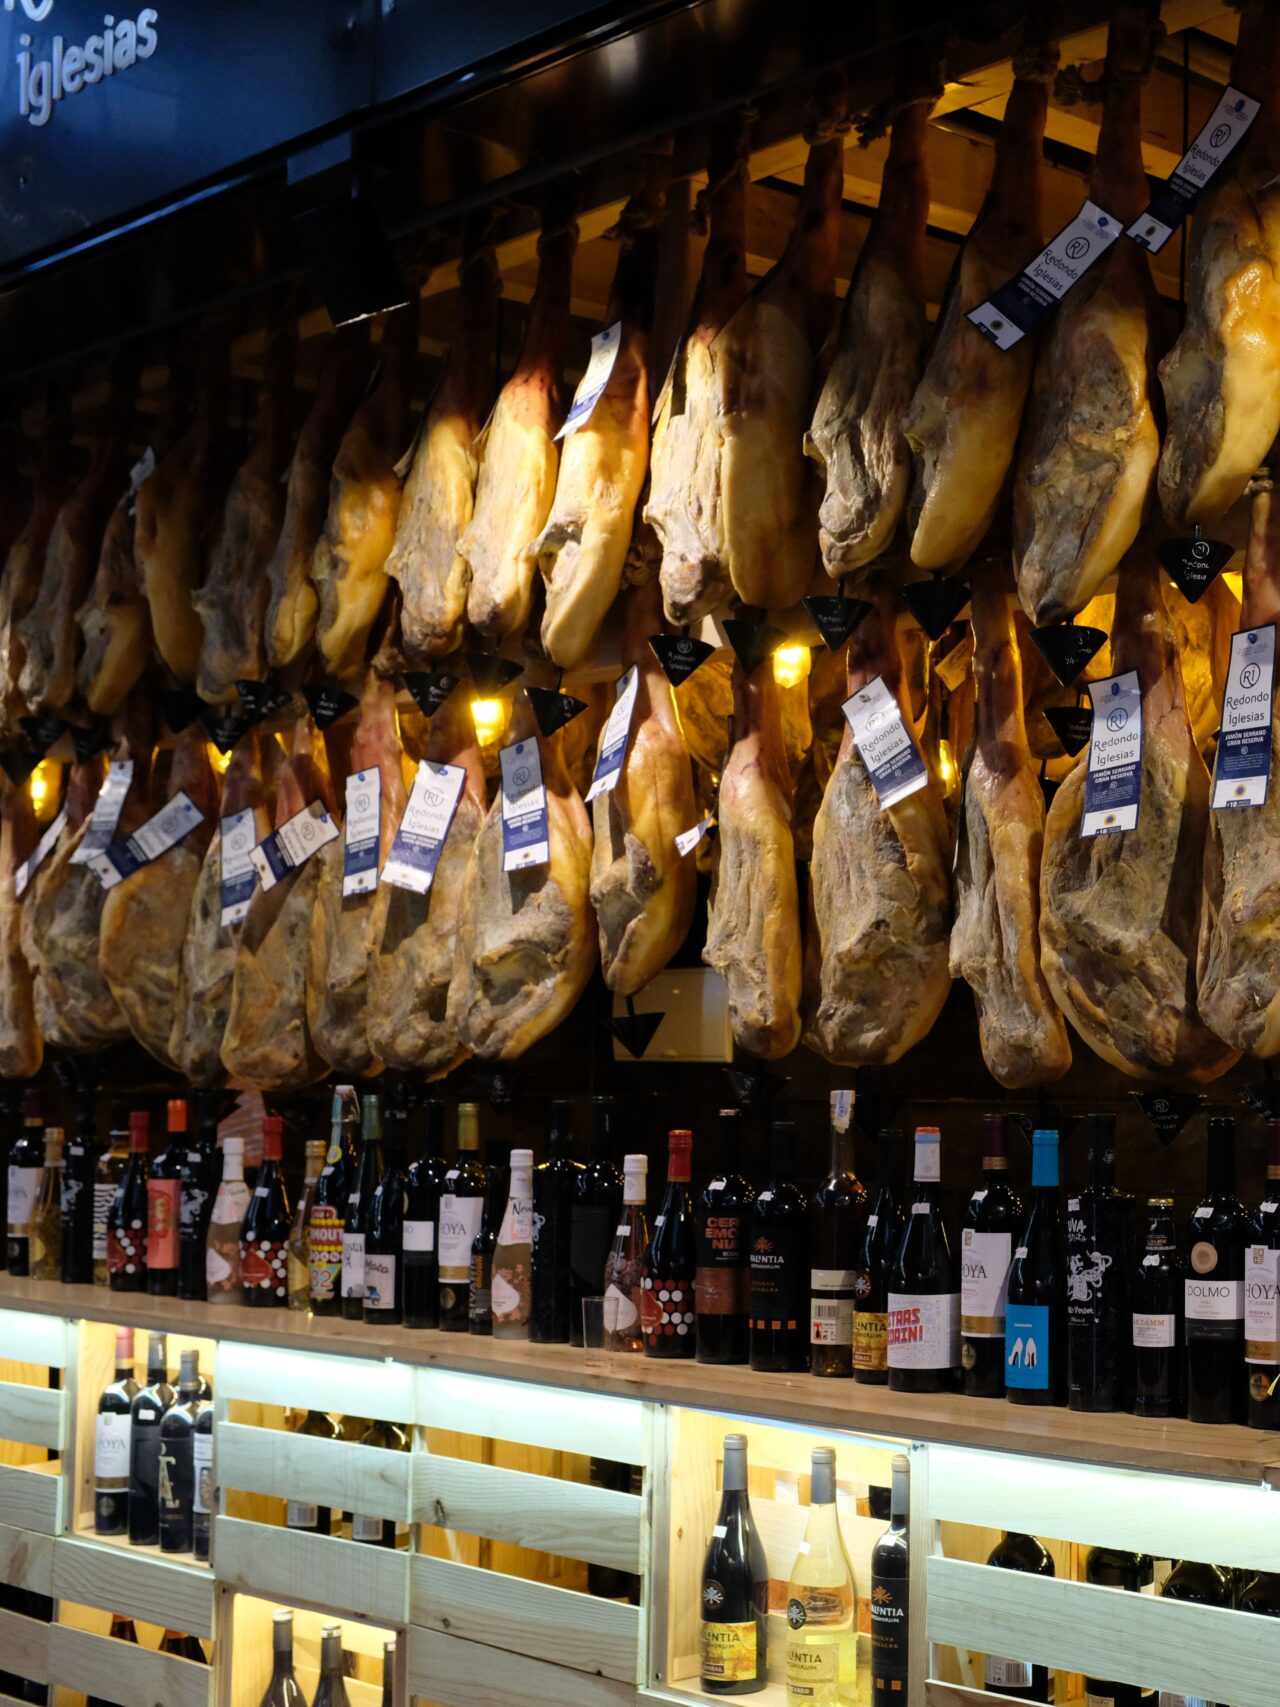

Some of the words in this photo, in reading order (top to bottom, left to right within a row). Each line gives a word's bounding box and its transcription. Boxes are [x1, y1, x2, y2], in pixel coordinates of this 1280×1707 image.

[1042, 249, 1078, 280] Redondo
[1226, 692, 1269, 710] Redondo
[861, 722, 900, 754] Redondo
[1094, 732, 1139, 752] Redondo
[963, 1264, 987, 1279] OYA
[1187, 1285, 1230, 1298] DOLMO
